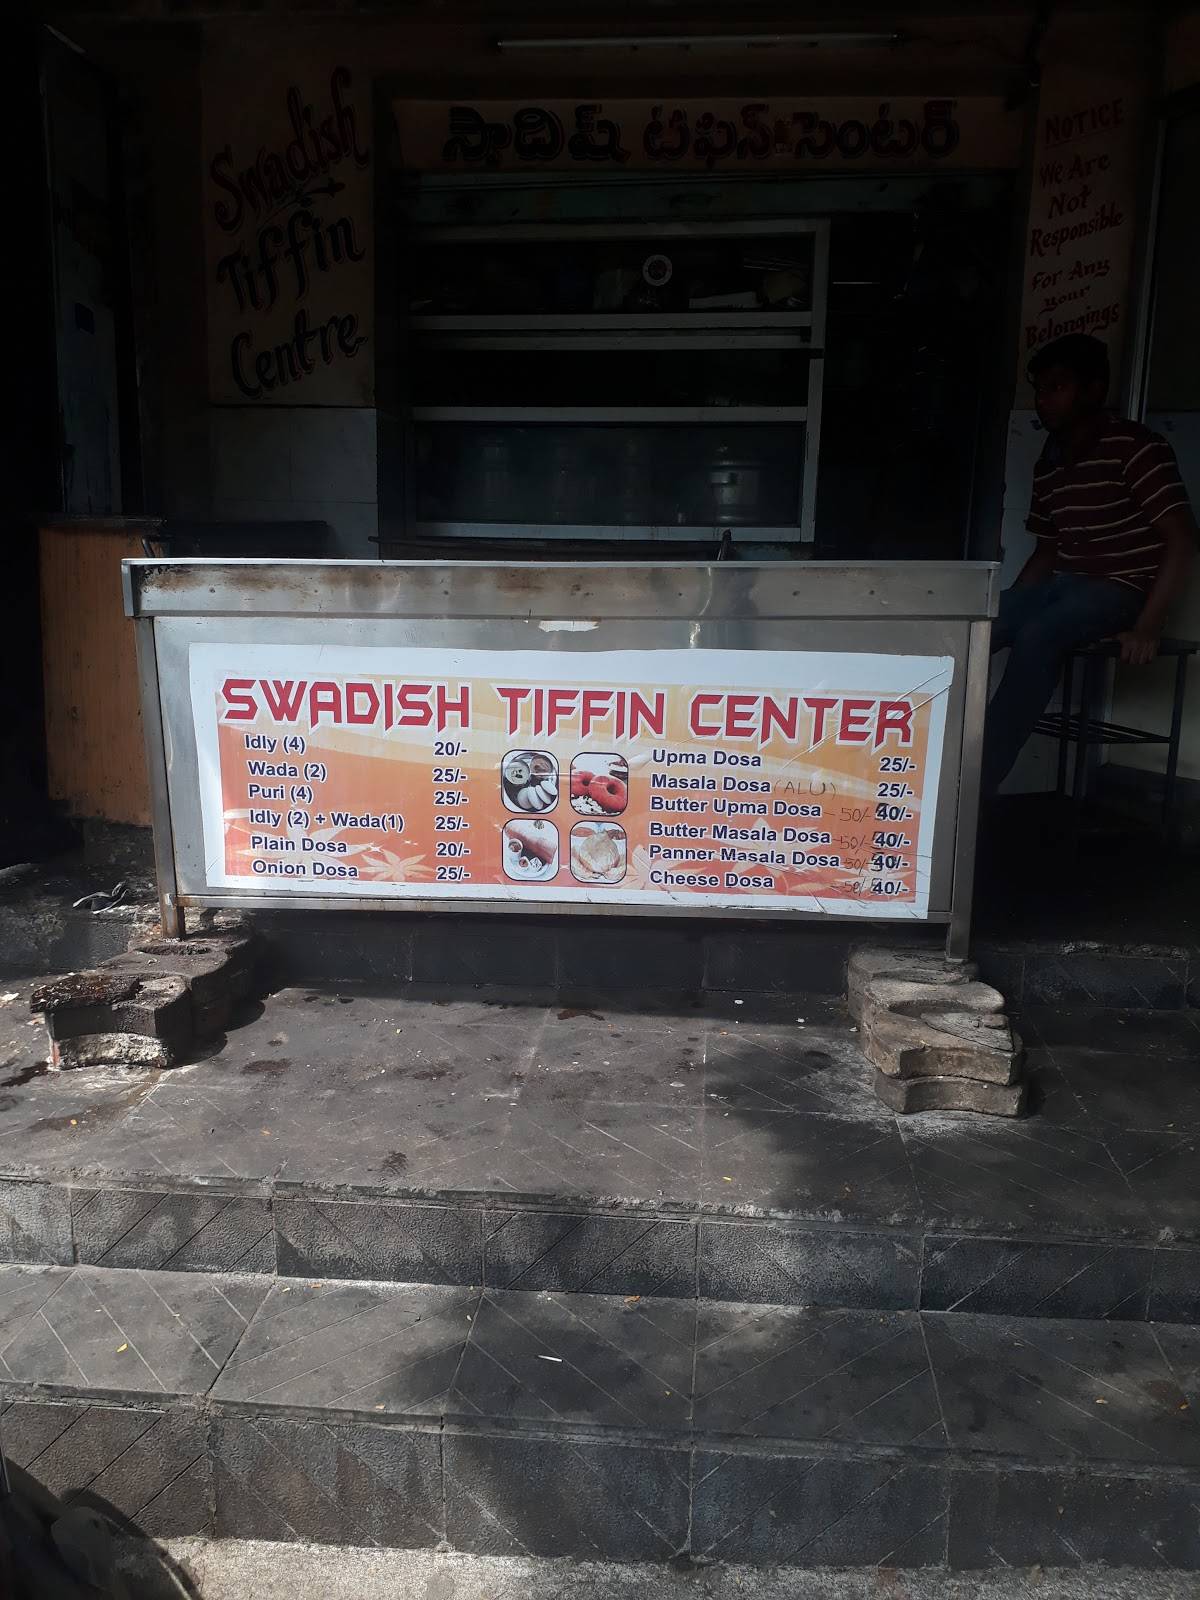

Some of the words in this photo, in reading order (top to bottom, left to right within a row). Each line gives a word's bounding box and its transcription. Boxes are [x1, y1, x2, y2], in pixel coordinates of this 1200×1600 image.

[1046, 97, 1124, 144] NOTICE
[211, 66, 369, 232] Swadish
[1040, 160, 1063, 188] We
[1068, 154, 1110, 180] Are
[1048, 185, 1091, 219] Not
[1031, 200, 1123, 257] Responsible
[216, 209, 366, 312] Tiffin
[1068, 260, 1110, 280] Any
[232, 308, 368, 399] Centre
[222, 678, 470, 733] SWADISH
[495, 687, 664, 741] TIFFIN
[688, 694, 913, 748] CENTER
[245, 735, 277, 754] Idly
[283, 736, 306, 755] (4)
[434, 741, 468, 757] 20/-
[248, 761, 298, 779] Wada
[303, 763, 327, 781] (2)
[433, 768, 467, 784] 25/-
[652, 749, 707, 768] Upma
[713, 750, 762, 768] Dosa
[880, 757, 916, 773] 25/-
[651, 773, 717, 791] Masala
[722, 775, 771, 793] Dosa
[877, 782, 914, 798] 25/-
[249, 783, 284, 800] Puri
[290, 786, 313, 804] (4)
[434, 790, 468, 807] 25/-
[651, 796, 707, 813] Butter
[713, 798, 767, 816] Upma
[773, 801, 821, 817] Dosa
[249, 809, 281, 828] Idly
[287, 811, 310, 829] (2)
[315, 814, 326, 826] +
[330, 812, 404, 832] Wada(1)
[435, 816, 469, 832] 25/-
[650, 822, 707, 839] Butter
[712, 824, 777, 842] Masala
[783, 826, 831, 844] Dosa
[251, 836, 296, 852] Plain
[301, 838, 348, 854] Dosa
[436, 842, 471, 858] 20/-
[649, 845, 715, 861] Panner
[720, 847, 786, 865] Masala
[791, 850, 840, 868] Dosa
[252, 859, 306, 876] Onion
[312, 861, 358, 878] Dosa
[436, 866, 471, 882] 25/-
[650, 870, 719, 887] Cheese
[725, 872, 774, 889] Dosa
